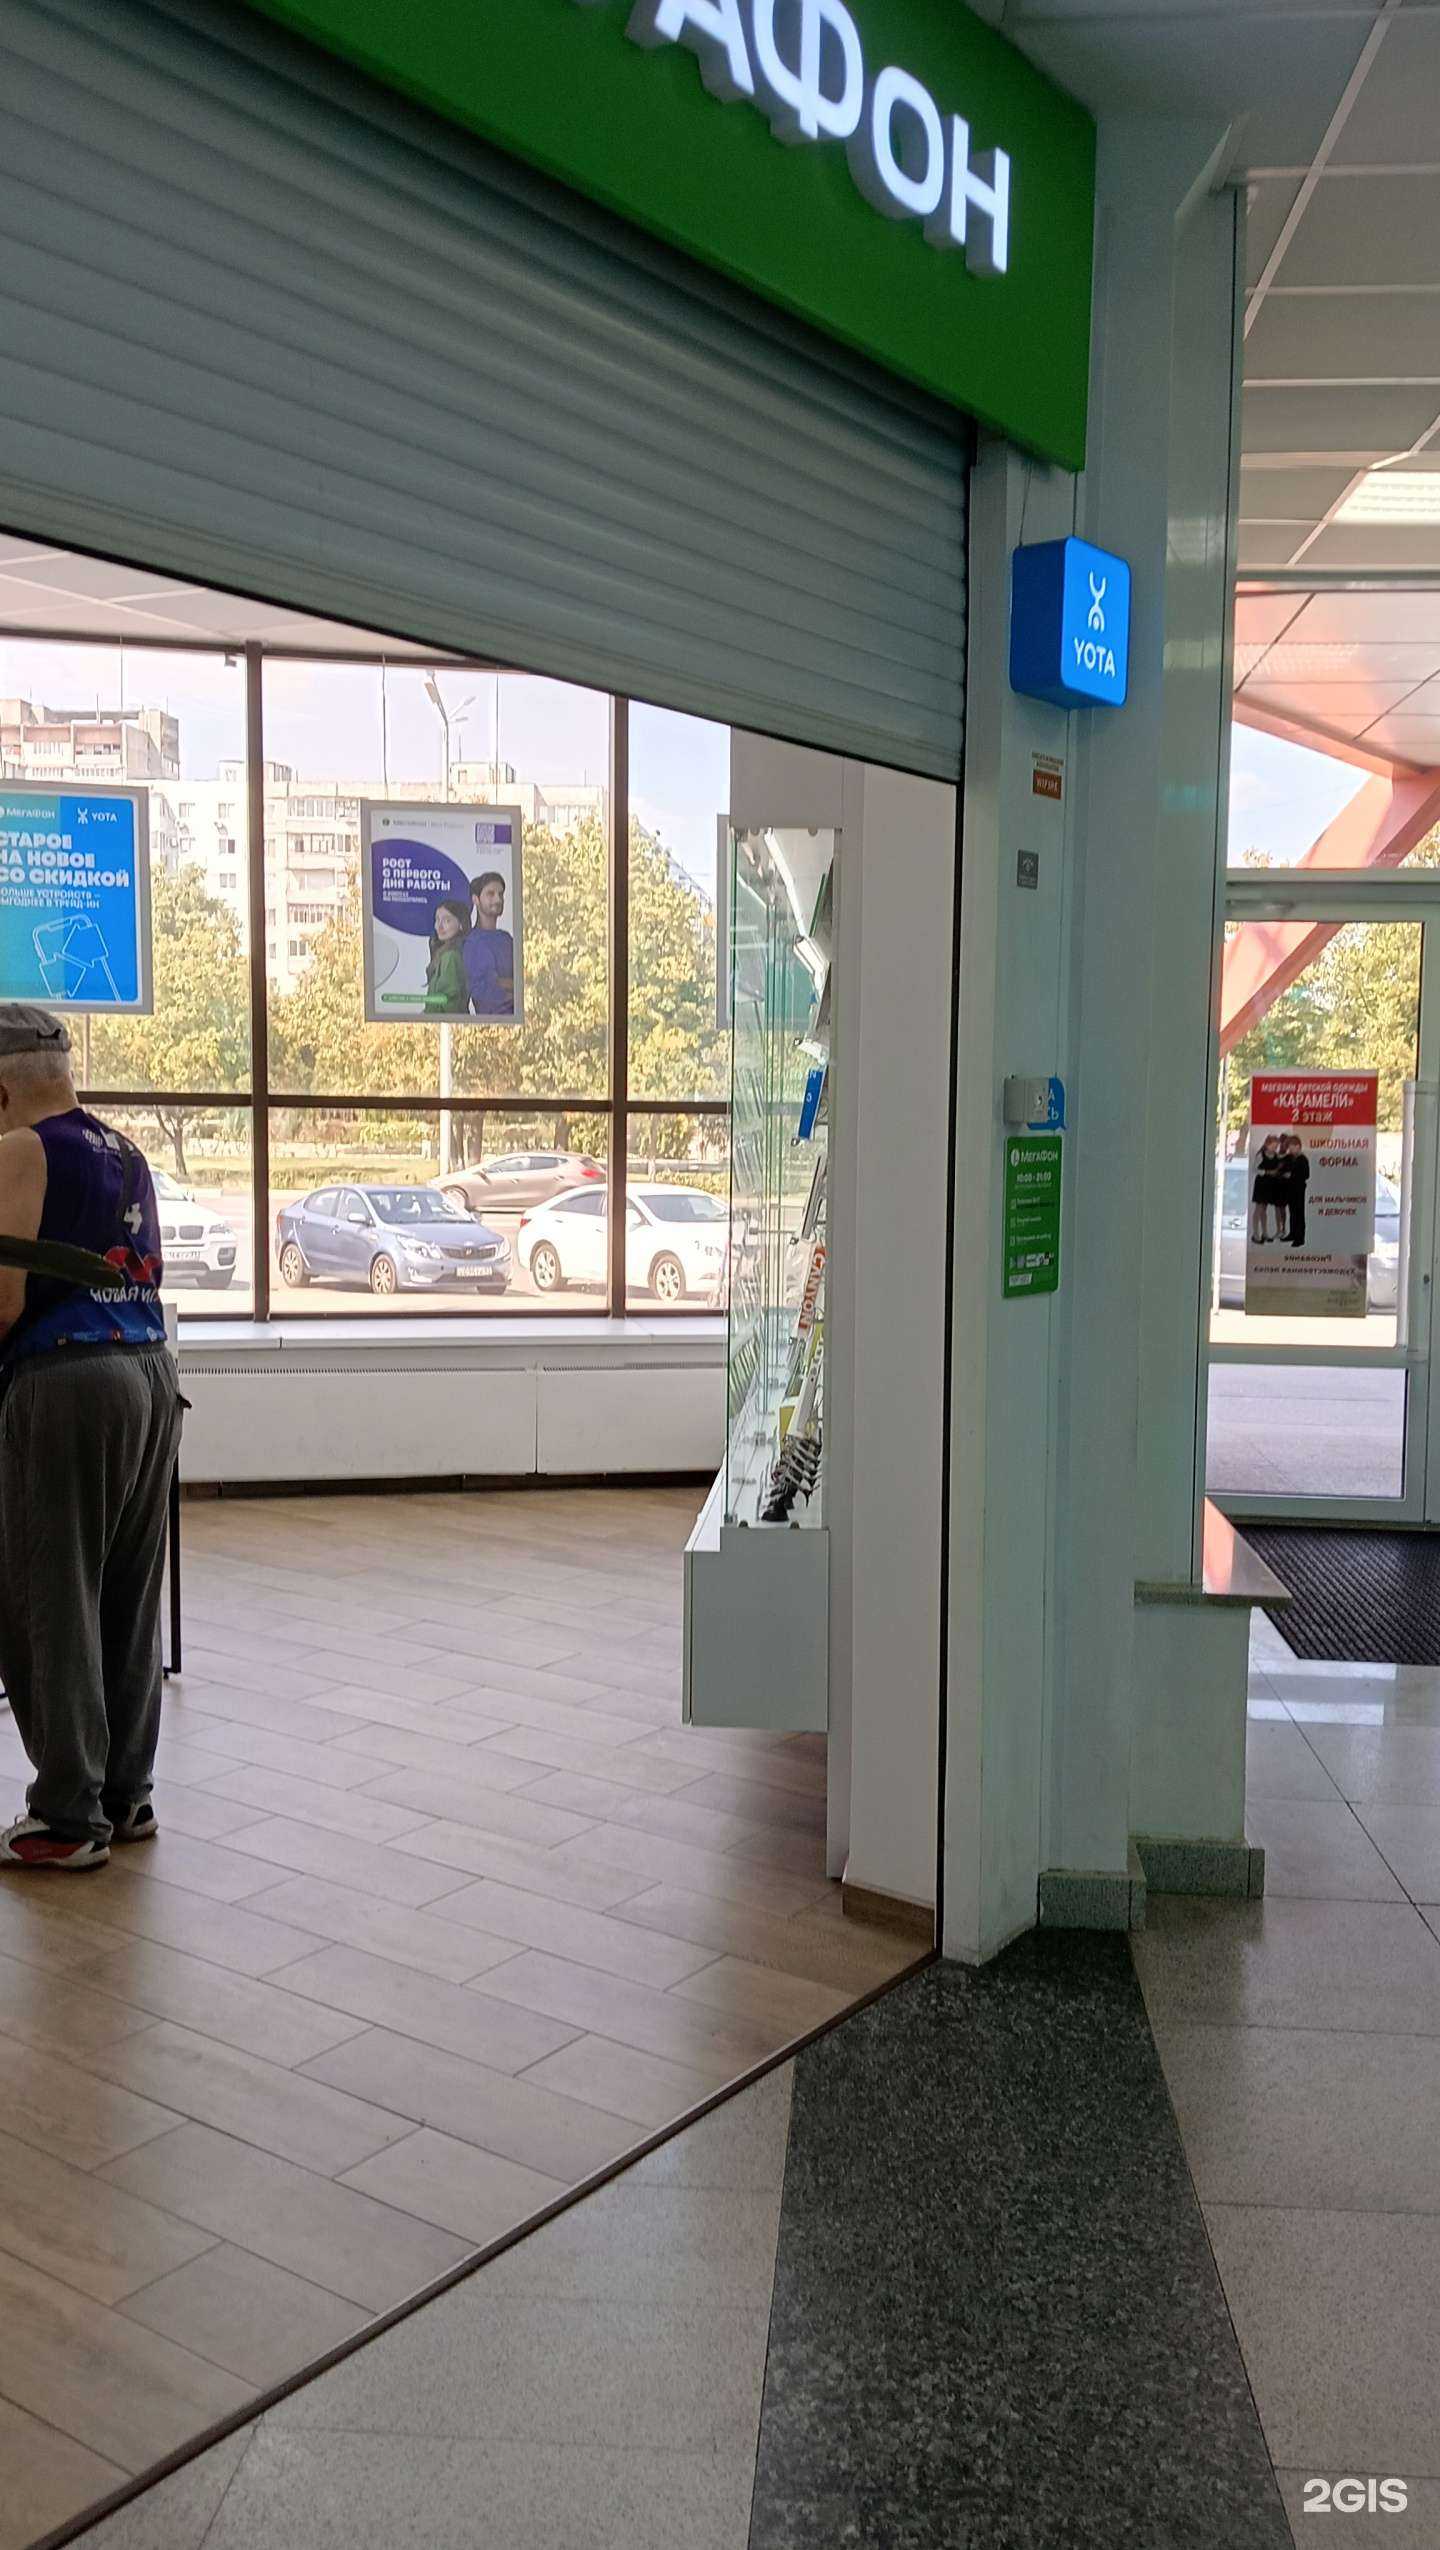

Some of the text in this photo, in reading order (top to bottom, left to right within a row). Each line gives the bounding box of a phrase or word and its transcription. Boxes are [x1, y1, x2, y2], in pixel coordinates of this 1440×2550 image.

[1073, 637, 1116, 678] YOTA
[91, 812, 118, 823] YOTA
[27, 851, 95, 868] НОВОЕ
[29, 869, 130, 888] СКИДКОЙ
[393, 869, 441, 880] ПЕРВОГО
[382, 879, 451, 891] ДНЯ РАБОТЫ
[1309, 1138, 1369, 1149] ШКОЛЬНАЯ
[1318, 1156, 1359, 1168] ФОРМА
